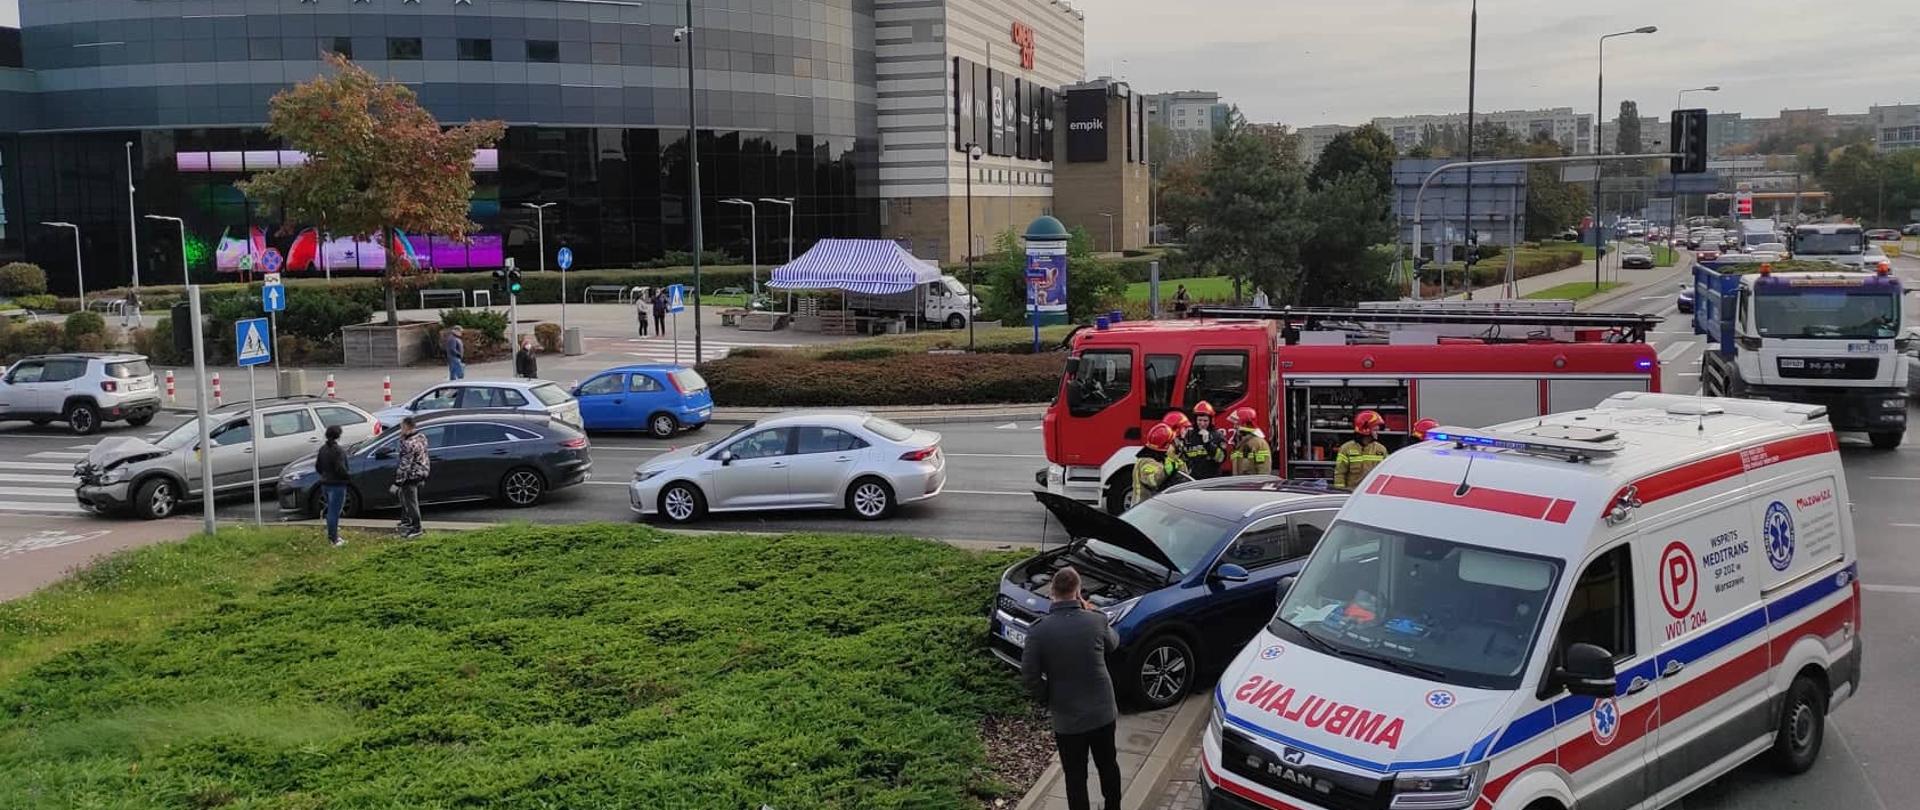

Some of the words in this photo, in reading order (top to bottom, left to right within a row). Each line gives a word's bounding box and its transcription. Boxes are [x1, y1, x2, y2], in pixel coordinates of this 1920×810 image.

[1069, 118, 1103, 131] empik
[1702, 541, 1749, 568] MEDITRANS
[1669, 555, 1688, 605] P
[1665, 617, 1687, 641] W01
[1690, 609, 1707, 630] 204
[1267, 762, 1313, 789] MAN
